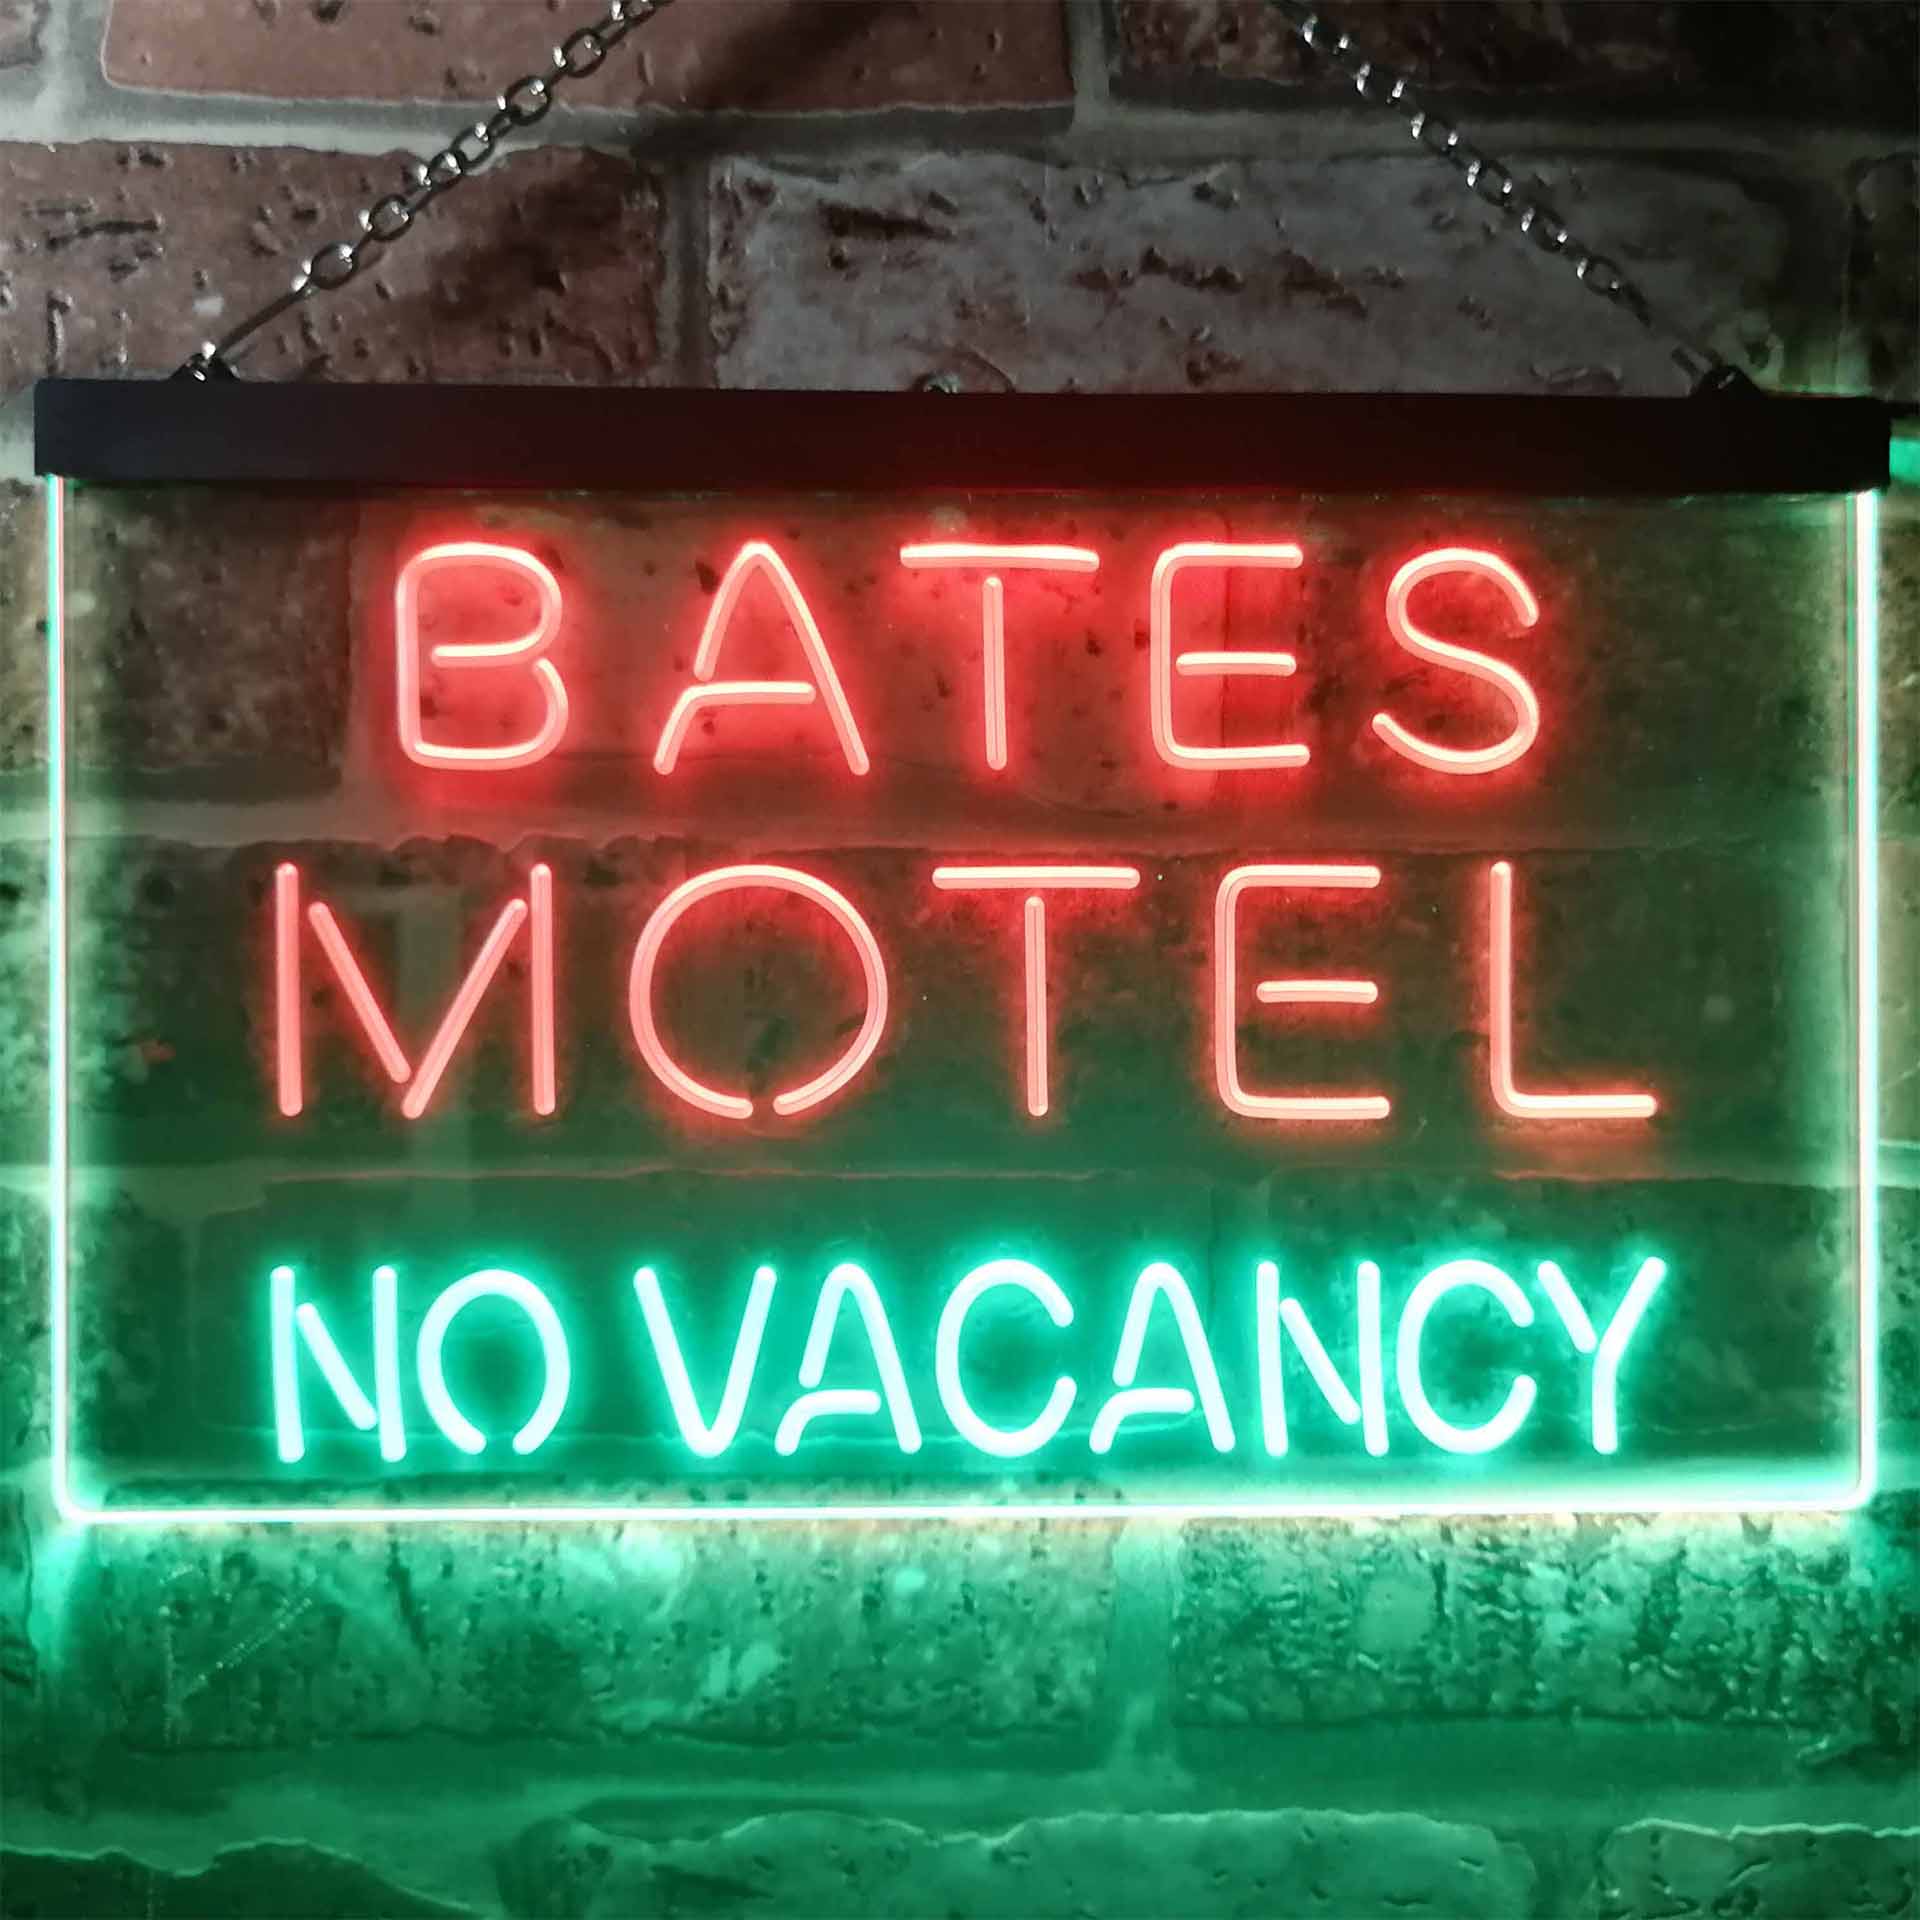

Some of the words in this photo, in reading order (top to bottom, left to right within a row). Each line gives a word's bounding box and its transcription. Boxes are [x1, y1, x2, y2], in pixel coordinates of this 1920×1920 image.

[394, 538, 1541, 777] BATES
[275, 861, 1658, 1120] MOTEL
[268, 1264, 573, 1464] NO
[632, 1254, 1668, 1460] VACANCY
